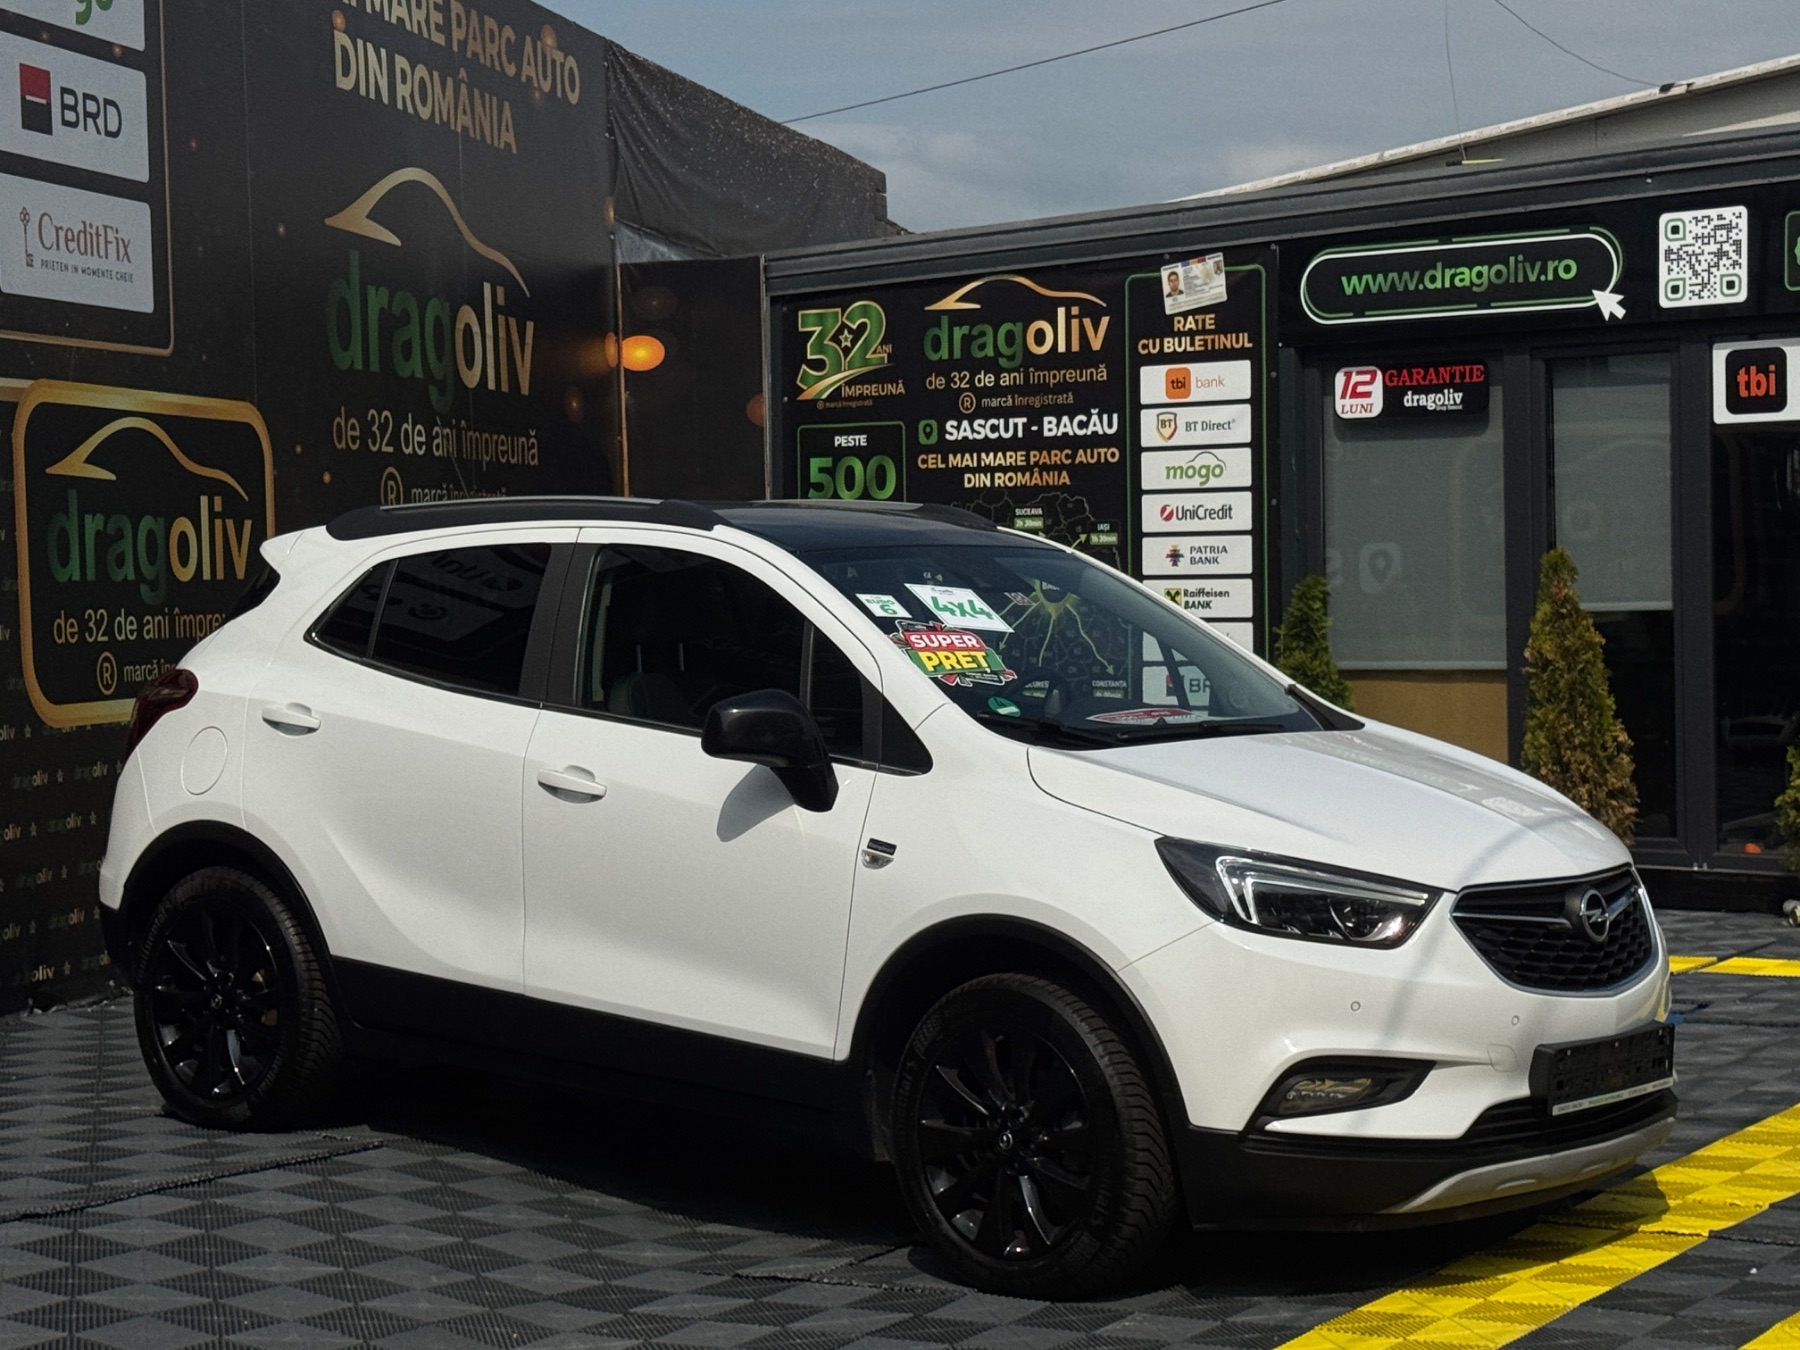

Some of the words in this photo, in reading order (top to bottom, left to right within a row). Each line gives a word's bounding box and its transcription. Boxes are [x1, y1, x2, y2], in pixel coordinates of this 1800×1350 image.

[451, 2, 516, 78] PARC
[521, 35, 580, 105] AUTO
[333, 30, 389, 105] DIN
[394, 53, 518, 154] ROMÂNIA
[60, 86, 122, 139] BRD
[38, 212, 132, 264] CreditFix
[40, 258, 69, 274] PRIETEN
[71, 264, 79, 274] IN
[81, 266, 113, 280] MOMENTE
[115, 270, 133, 283] CHEIE
[1341, 254, 1578, 297] www.dragoliv.ro
[326, 251, 535, 414] dragoliv
[1173, 313, 1216, 332] RATE
[796, 301, 886, 391] 32
[923, 306, 1110, 369] dragoliv
[1137, 338, 1160, 355] CU
[1163, 332, 1253, 354] BULETINUL
[877, 344, 893, 354] ANI
[926, 373, 946, 390] de
[950, 371, 970, 388] 32
[975, 370, 995, 387] de
[1000, 368, 1024, 386] ani
[1029, 363, 1107, 387] împreună
[1170, 379, 1187, 391] tbi
[1195, 375, 1225, 388] bank
[1340, 369, 1377, 400] 12
[1385, 365, 1485, 387] GARANTIE
[1737, 364, 1777, 398] tbi
[841, 380, 905, 398] ÎMPREUNĂ
[1403, 389, 1463, 411] dragoliv
[981, 395, 1013, 408] marcă
[1015, 392, 1074, 409] înregistrată
[1340, 403, 1374, 415] LUNI
[945, 417, 1027, 442] SASCUT
[1043, 408, 1119, 437] BACĂU
[1160, 419, 1173, 430] BT
[1184, 421, 1199, 433] BT
[333, 406, 360, 450] de
[367, 408, 394, 453] 32
[400, 412, 427, 456] de
[432, 416, 457, 458] ani
[460, 418, 539, 472] împreună
[834, 434, 868, 448] PESTE
[917, 454, 945, 469] CEL
[949, 452, 977, 468] MAI
[981, 450, 1026, 468] MARE
[1029, 450, 1072, 465] PARC
[1075, 447, 1120, 464] AUTO
[808, 455, 896, 501] 500
[964, 472, 991, 489] DIN
[994, 467, 1071, 487] ROMÂNIA
[1165, 464, 1224, 487] mogo
[1015, 508, 1043, 516] SUCEAVA
[1175, 504, 1233, 522] UniCredit
[47, 489, 252, 605] dragoliv
[1189, 545, 1228, 555] PATRIA
[1189, 557, 1220, 566] BANK
[1183, 588, 1230, 599] Raiffeisen
[880, 604, 898, 615] 6
[1183, 600, 1213, 610] BANK
[53, 609, 79, 645] de
[84, 608, 109, 643] 32
[114, 608, 138, 642] de
[143, 607, 170, 640] ani
[173, 606, 227, 642] împre
[909, 634, 980, 648] SUPER
[917, 651, 991, 673] PREȚ
